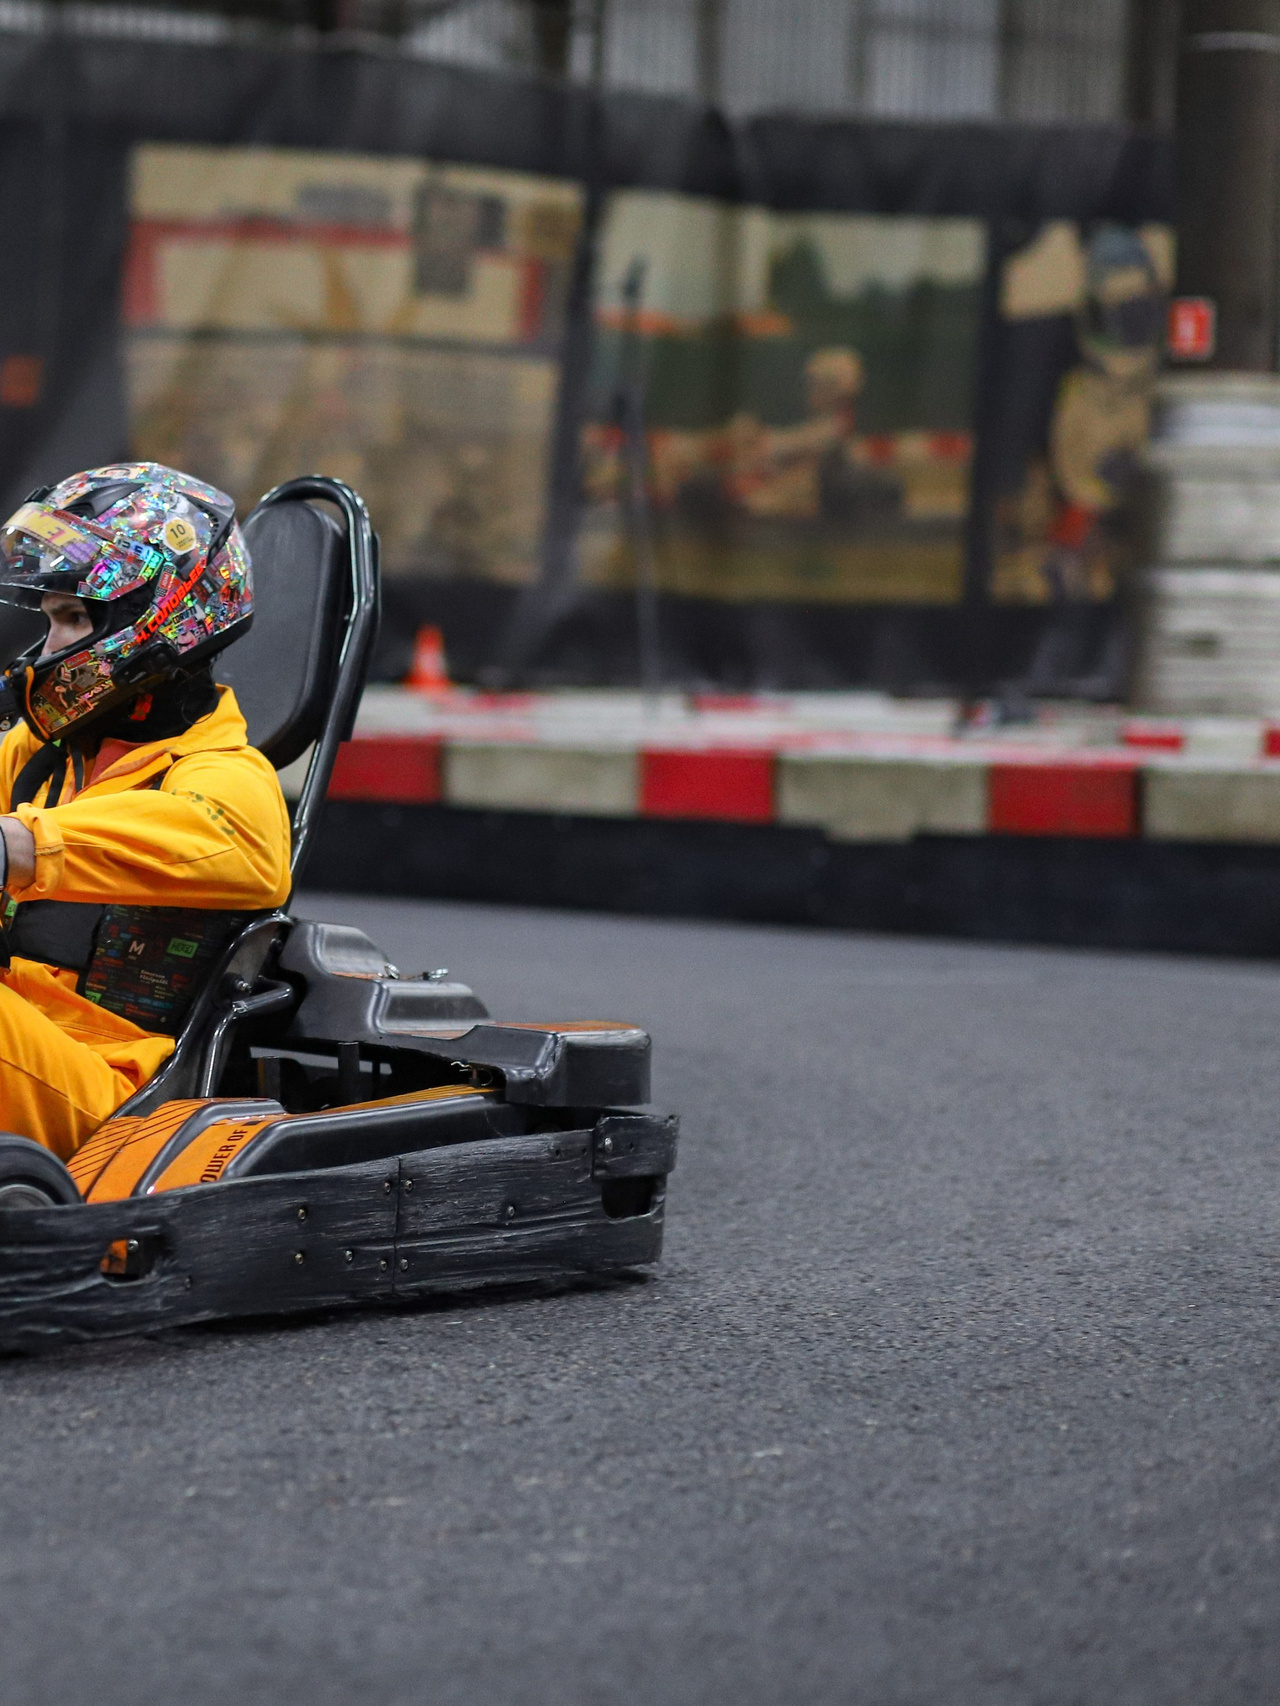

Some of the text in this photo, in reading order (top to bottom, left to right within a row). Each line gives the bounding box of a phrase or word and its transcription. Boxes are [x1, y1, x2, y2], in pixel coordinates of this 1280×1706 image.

[170, 523, 186, 539] 10
[199, 1129, 248, 1183] OWER OF
